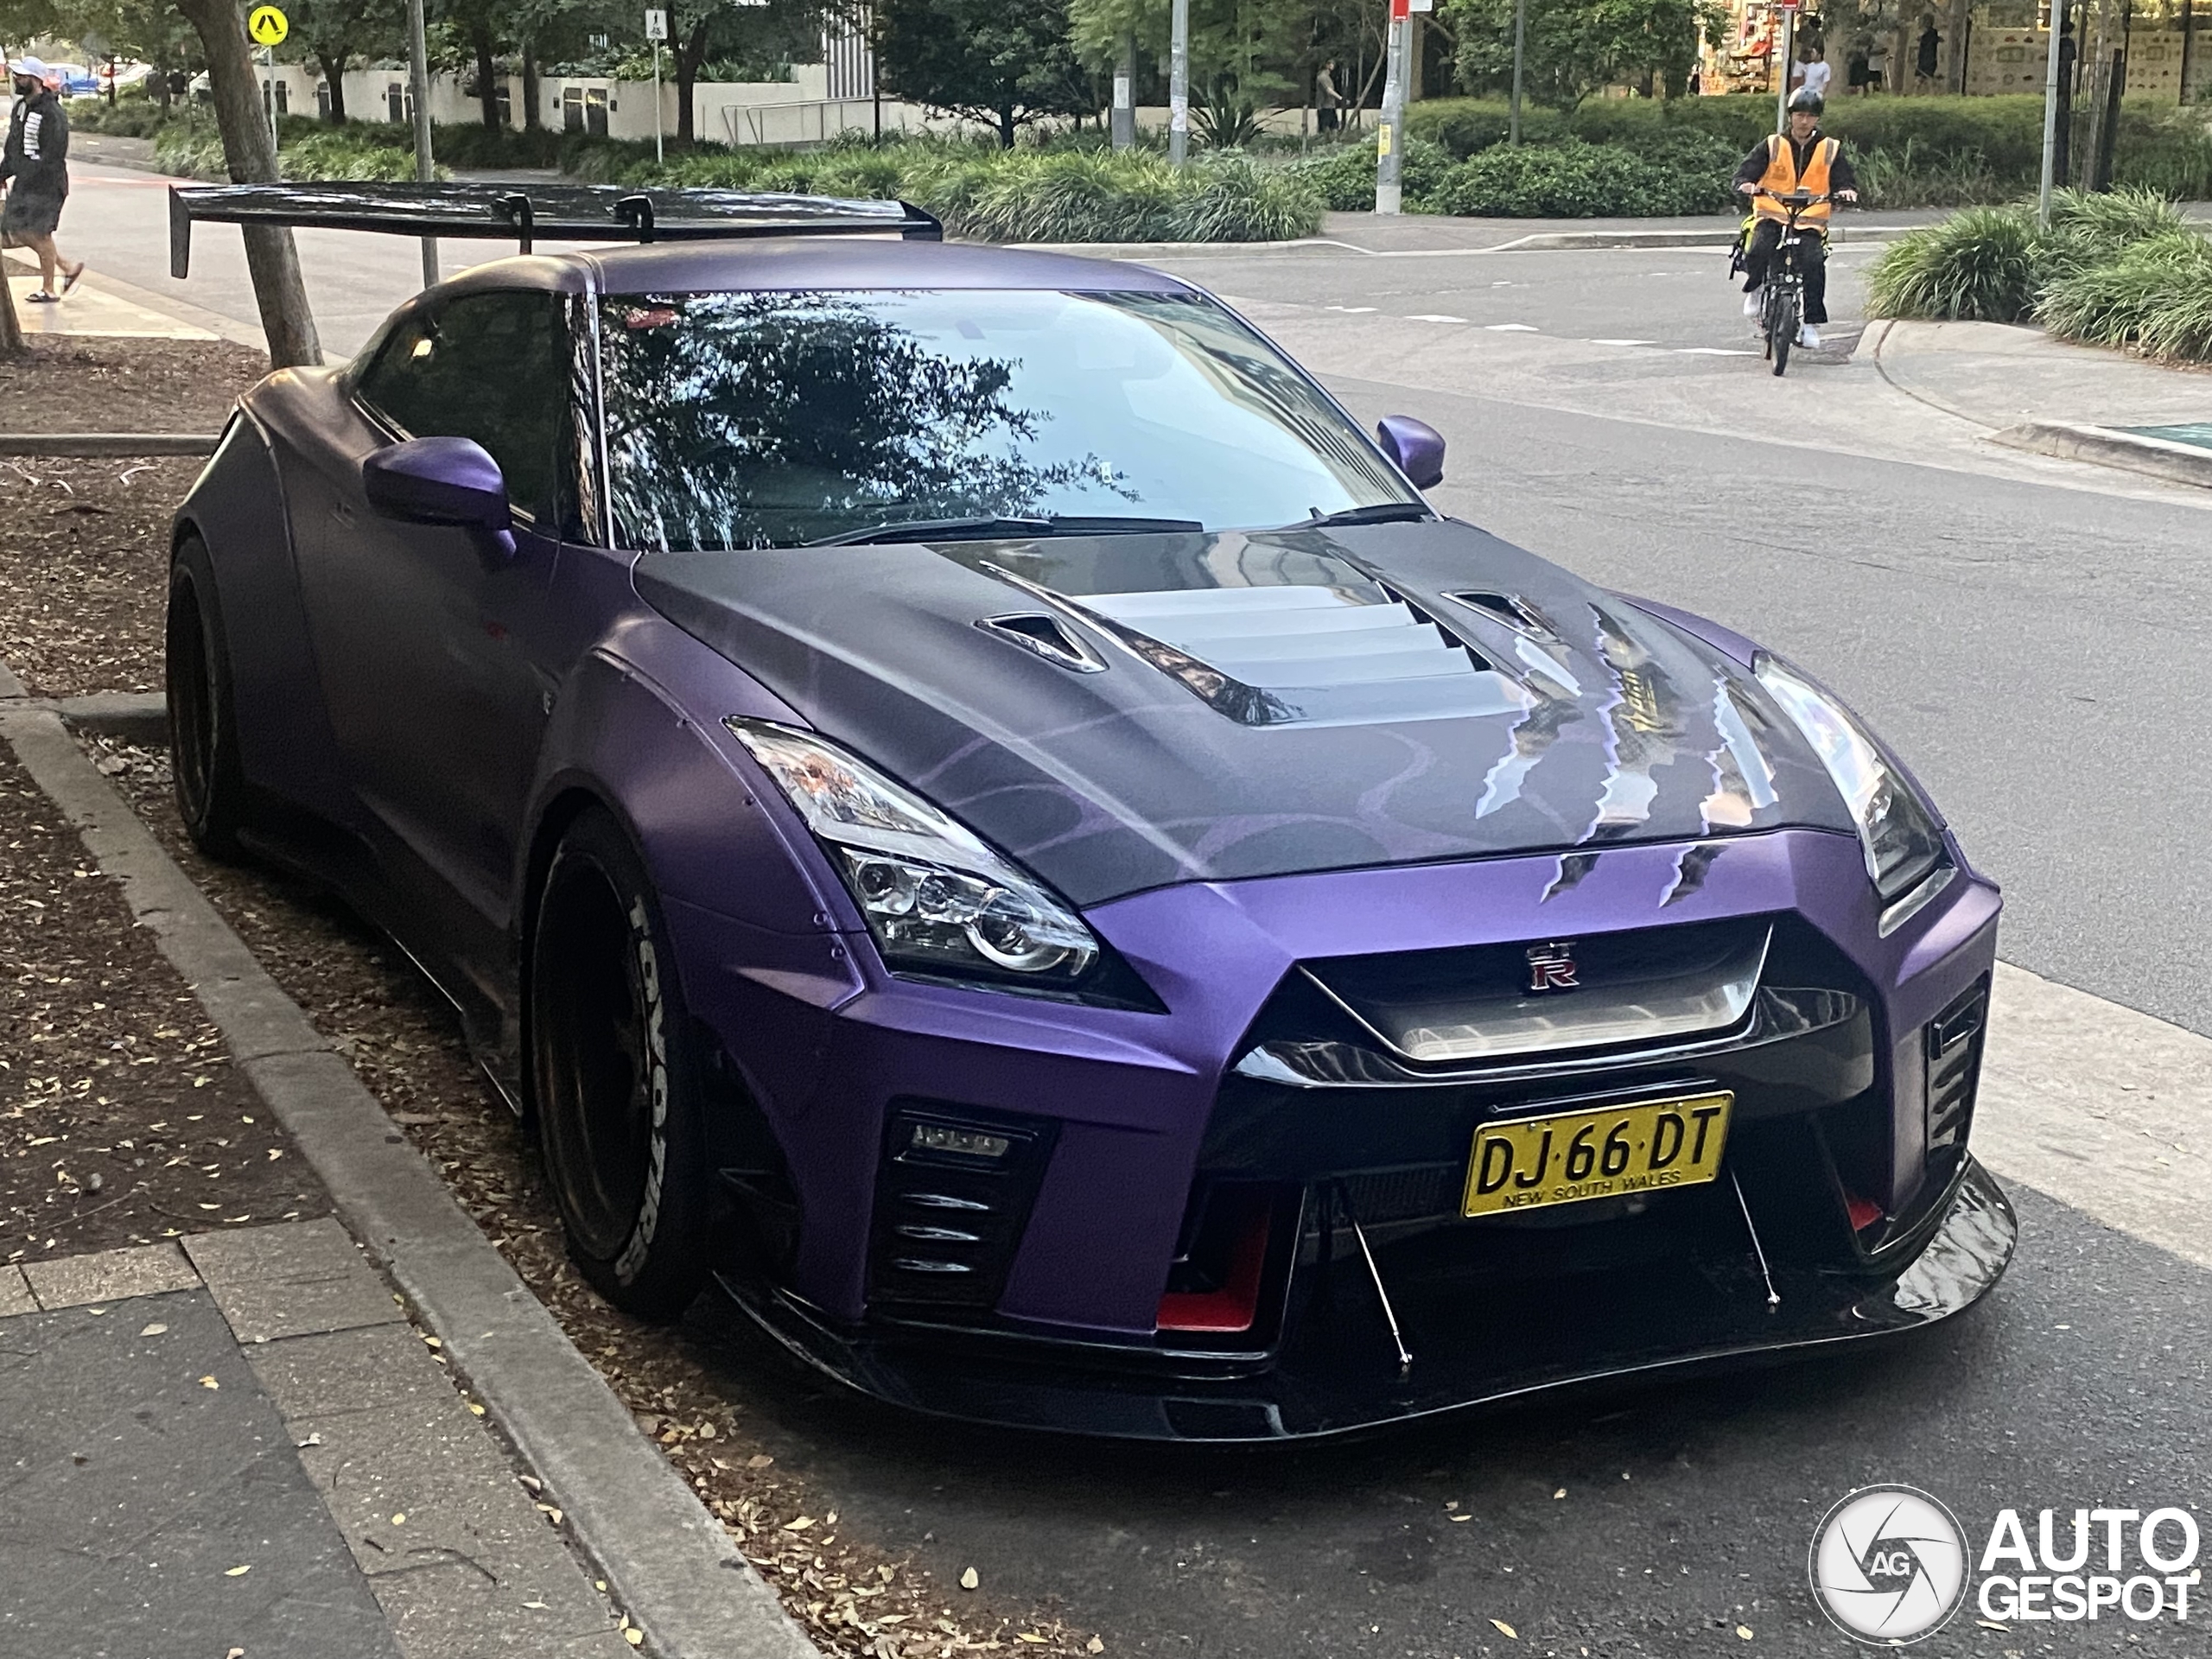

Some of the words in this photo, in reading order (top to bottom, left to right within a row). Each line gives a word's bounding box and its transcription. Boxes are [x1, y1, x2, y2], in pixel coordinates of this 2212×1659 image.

[630, 894, 668, 1128] TOYO
[1502, 1194, 1545, 1209] NEW
[1553, 1181, 1614, 1202] SOUTH
[1620, 1170, 1681, 1191] WALES
